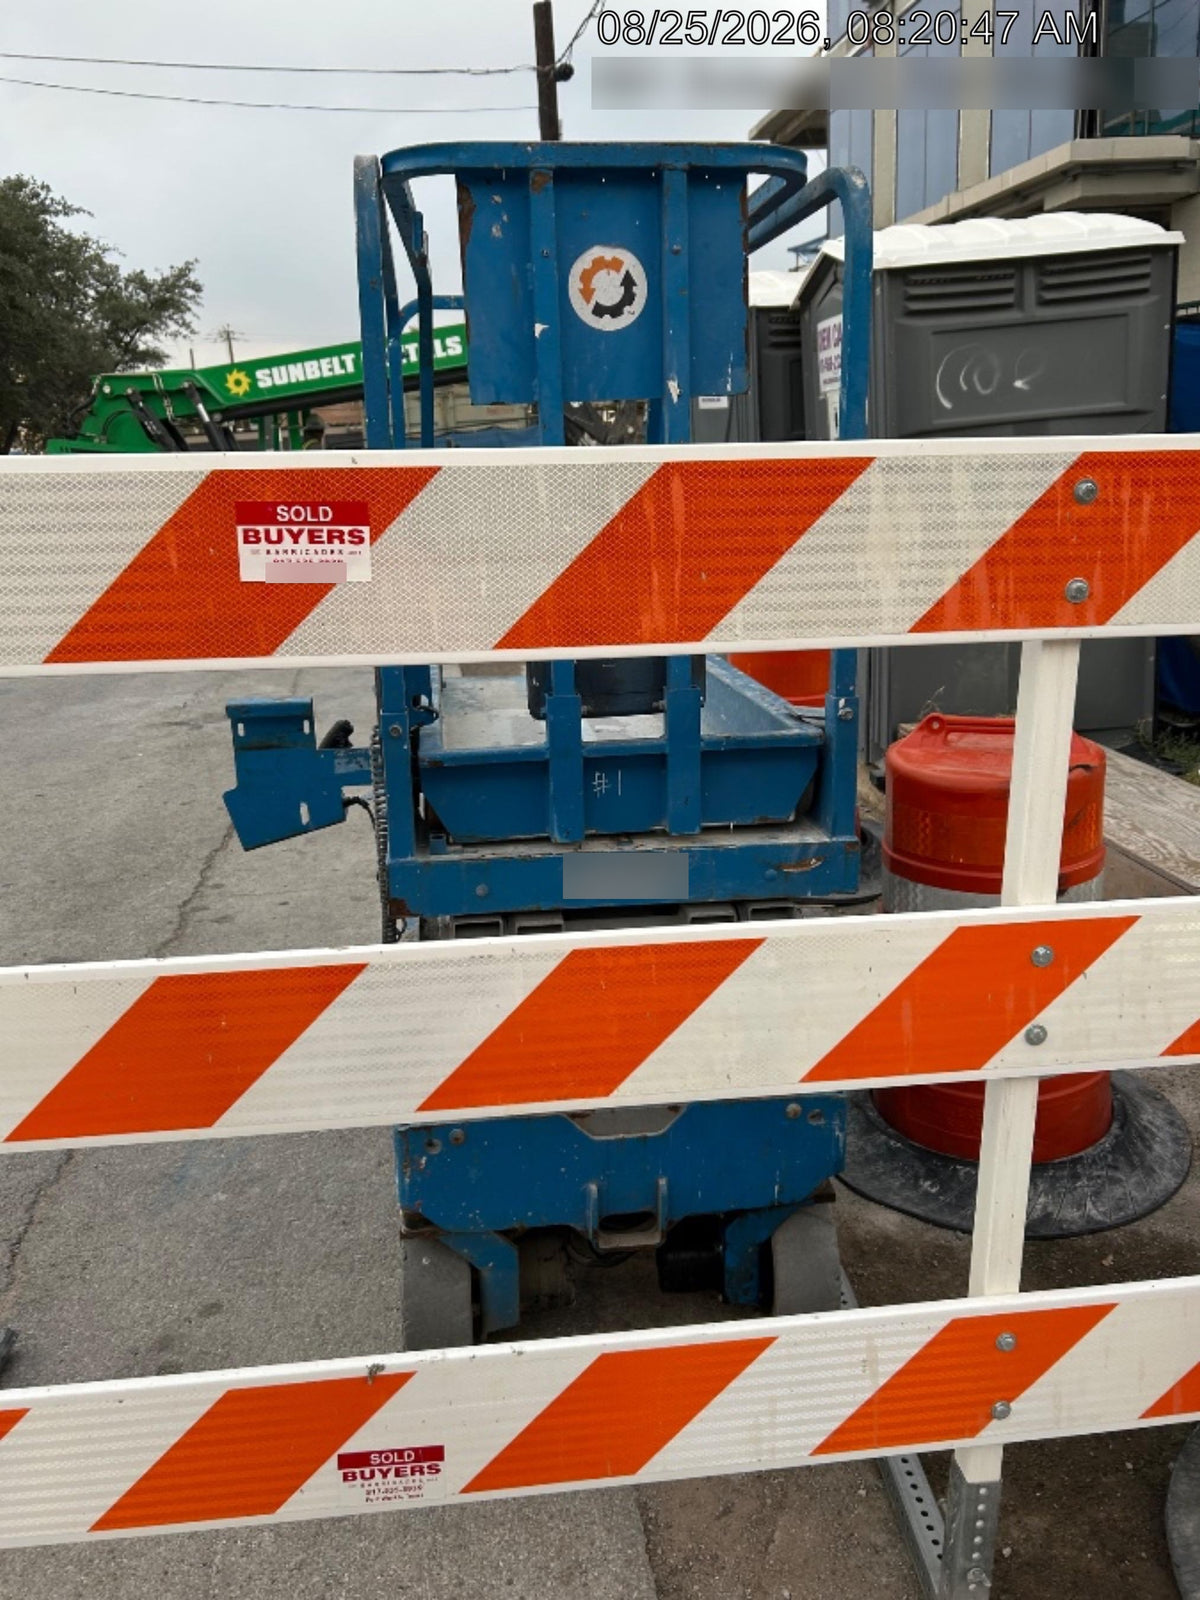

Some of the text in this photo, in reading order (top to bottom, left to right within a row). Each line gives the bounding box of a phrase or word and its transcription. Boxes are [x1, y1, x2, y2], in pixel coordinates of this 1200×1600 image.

[255, 353, 356, 389] SUNBELT
[276, 505, 333, 522] SOLD
[242, 528, 365, 545] BUYERS
[370, 1450, 415, 1465] SOLD
[342, 1463, 442, 1483] BUYERS
